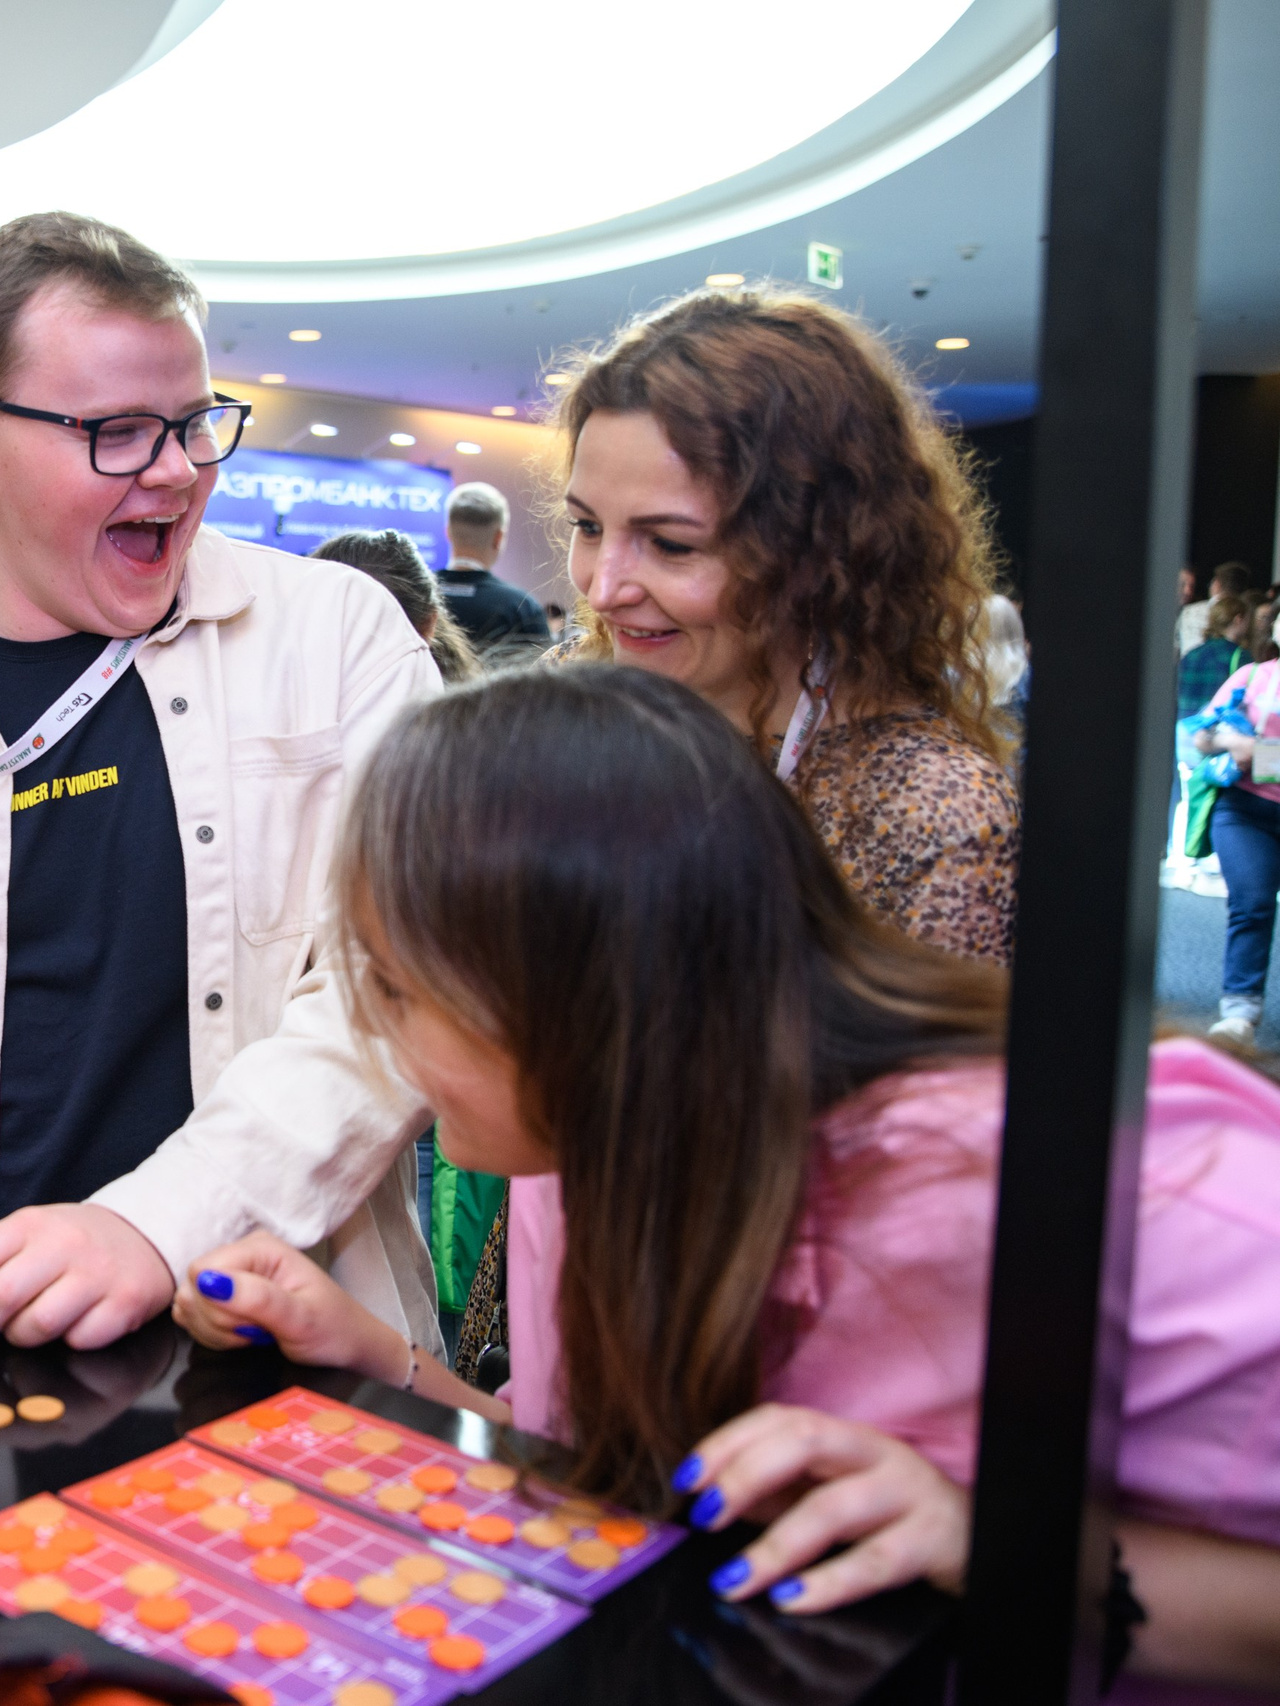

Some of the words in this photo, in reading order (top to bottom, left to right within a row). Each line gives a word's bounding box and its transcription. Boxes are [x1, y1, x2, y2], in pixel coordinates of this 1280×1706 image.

[101, 667, 114, 680] #18
[56, 704, 75, 723] Tech
[9, 747, 32, 767] ANALYST
[64, 765, 119, 798] VINDEN
